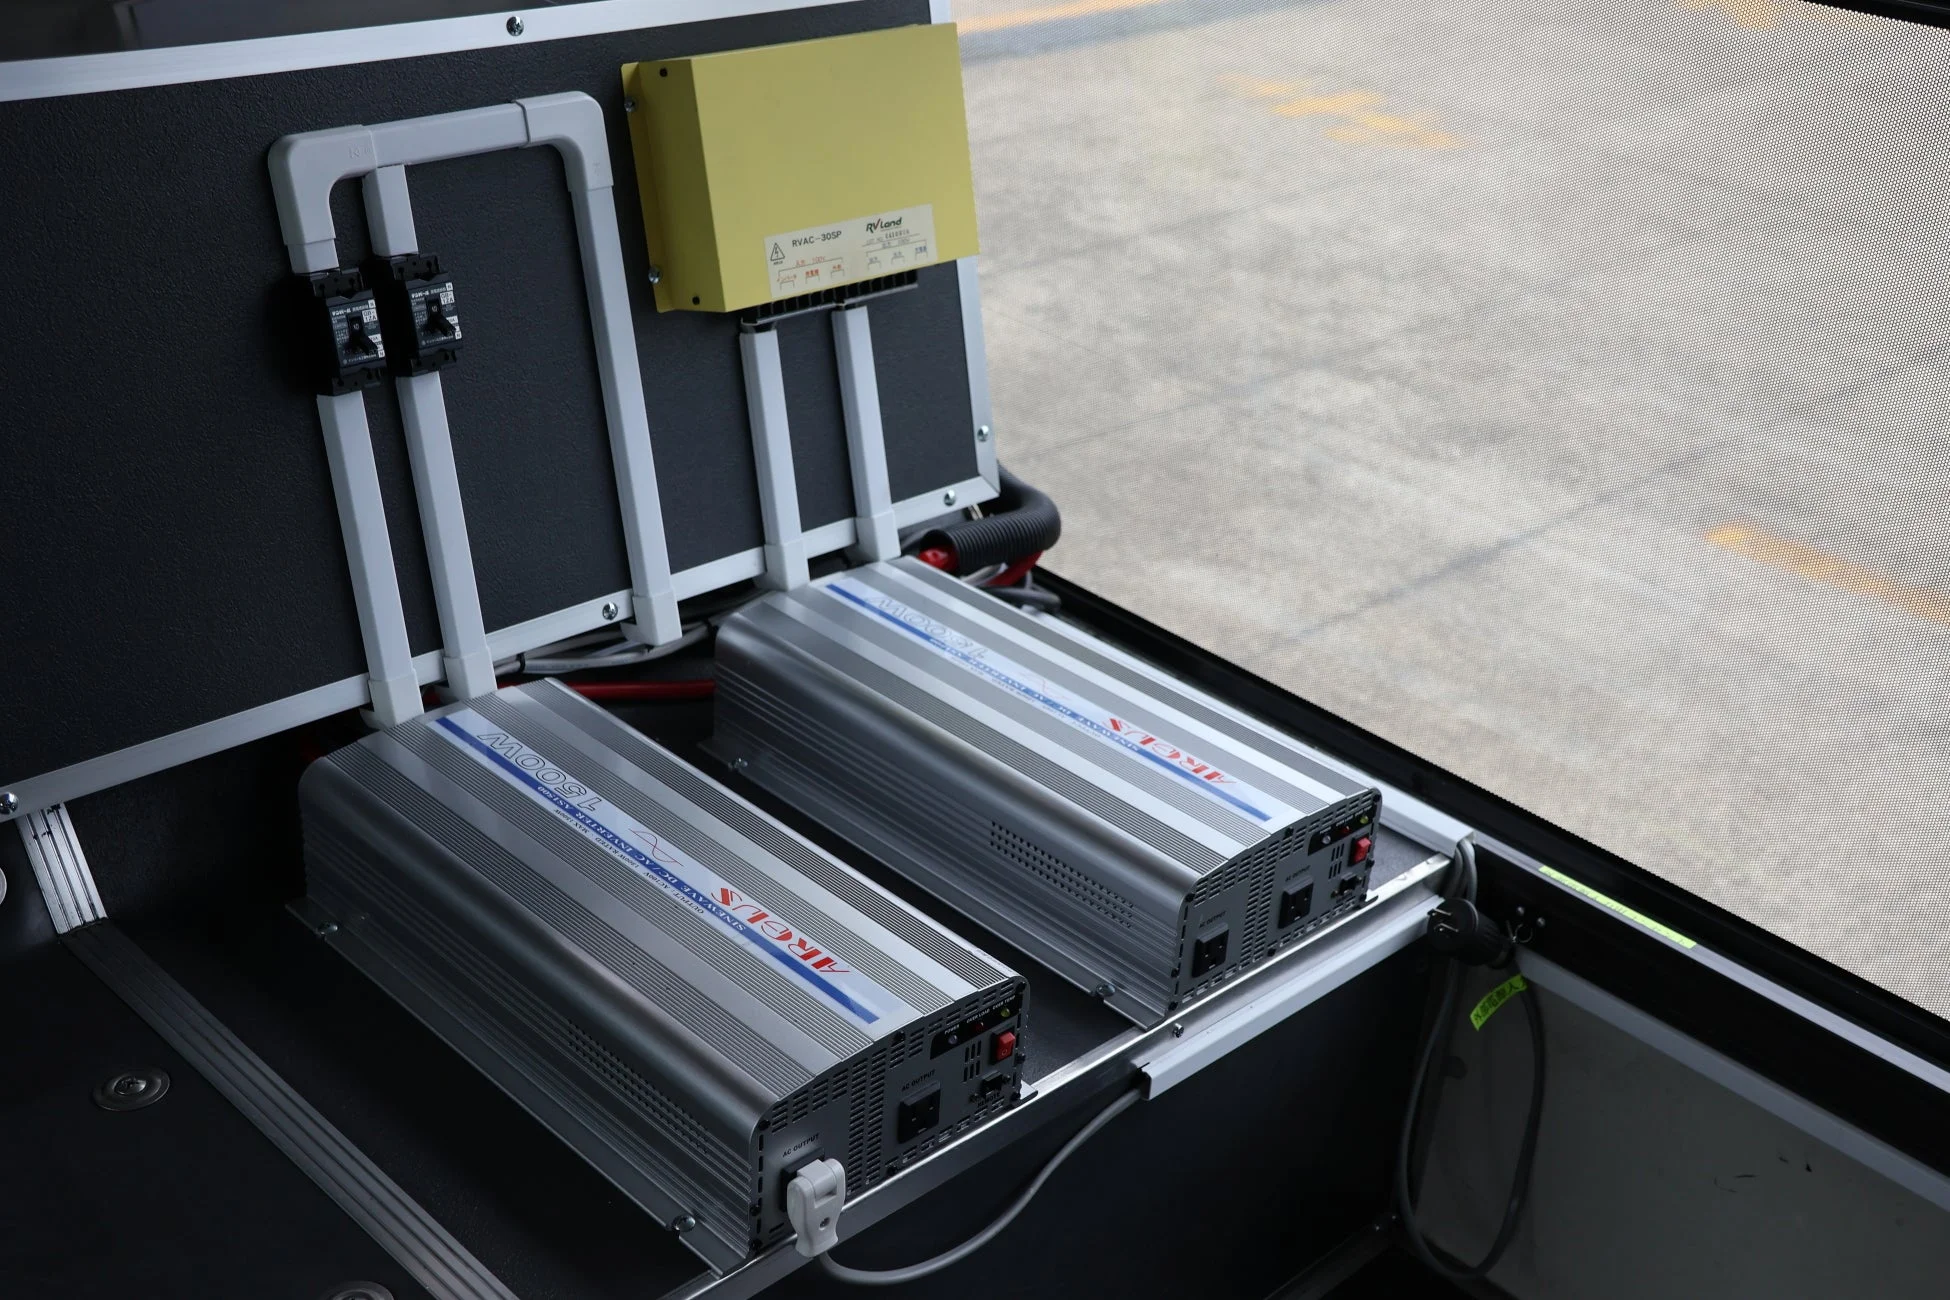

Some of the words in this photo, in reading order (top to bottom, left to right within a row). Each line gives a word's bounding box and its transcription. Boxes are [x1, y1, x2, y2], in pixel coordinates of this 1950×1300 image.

[791, 231, 842, 247] RVAC-30SP
[476, 731, 604, 813] 1500W
[537, 785, 574, 811] AS1500
[575, 811, 633, 854] INVERTER
[642, 870, 671, 890] AC100V
[681, 884, 746, 932] SINEWAVE
[711, 886, 851, 975] ARGUS
[902, 1082, 910, 1091] AC
[911, 1068, 936, 1087] OUTPUT
[782, 1146, 792, 1158] AC
[793, 1133, 820, 1153] OUTPUT
